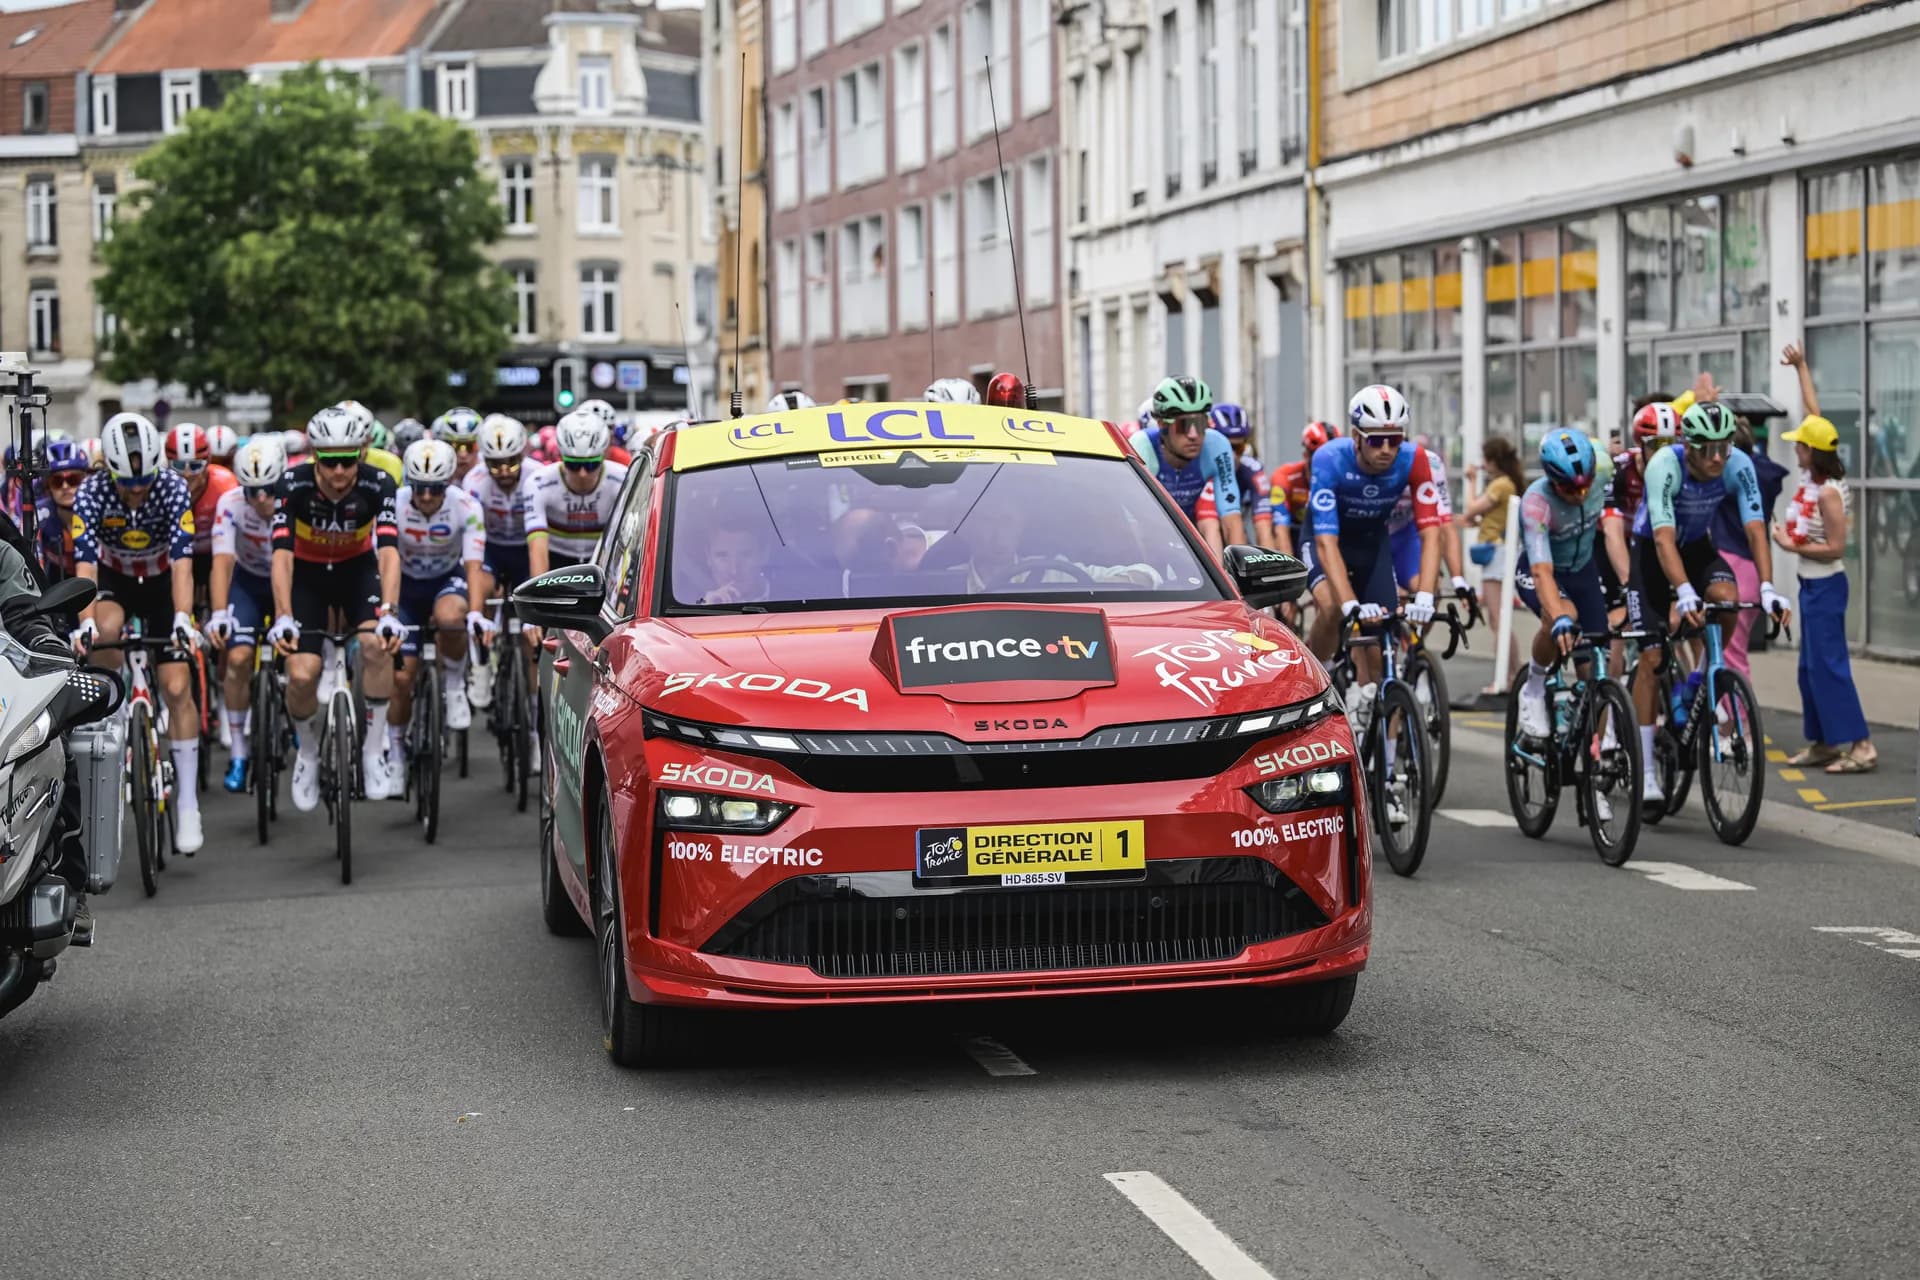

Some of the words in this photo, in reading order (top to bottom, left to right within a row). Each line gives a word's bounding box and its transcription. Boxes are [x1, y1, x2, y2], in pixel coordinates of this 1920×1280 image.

[733, 422, 794, 440] LCL
[826, 409, 975, 442] LCL
[1007, 417, 1066, 434] LCL
[824, 453, 885, 464] OFFICIEL
[312, 517, 357, 532] UAE
[536, 575, 594, 587] SKODA
[658, 672, 869, 713] SKODA
[974, 718, 1068, 731] SKODA
[1253, 740, 1350, 775] SKODA
[659, 763, 776, 794] SKODA
[1231, 827, 1279, 848] 100%
[1282, 816, 1344, 842] ELECTRIC
[974, 831, 1093, 848] DIRECTION
[1116, 829, 1129, 858] 1
[668, 841, 713, 862] 100%
[720, 844, 824, 866] ELECTRIC
[975, 847, 1093, 865] GÉNÉRALE
[1005, 873, 1063, 885] HD-865-SV
